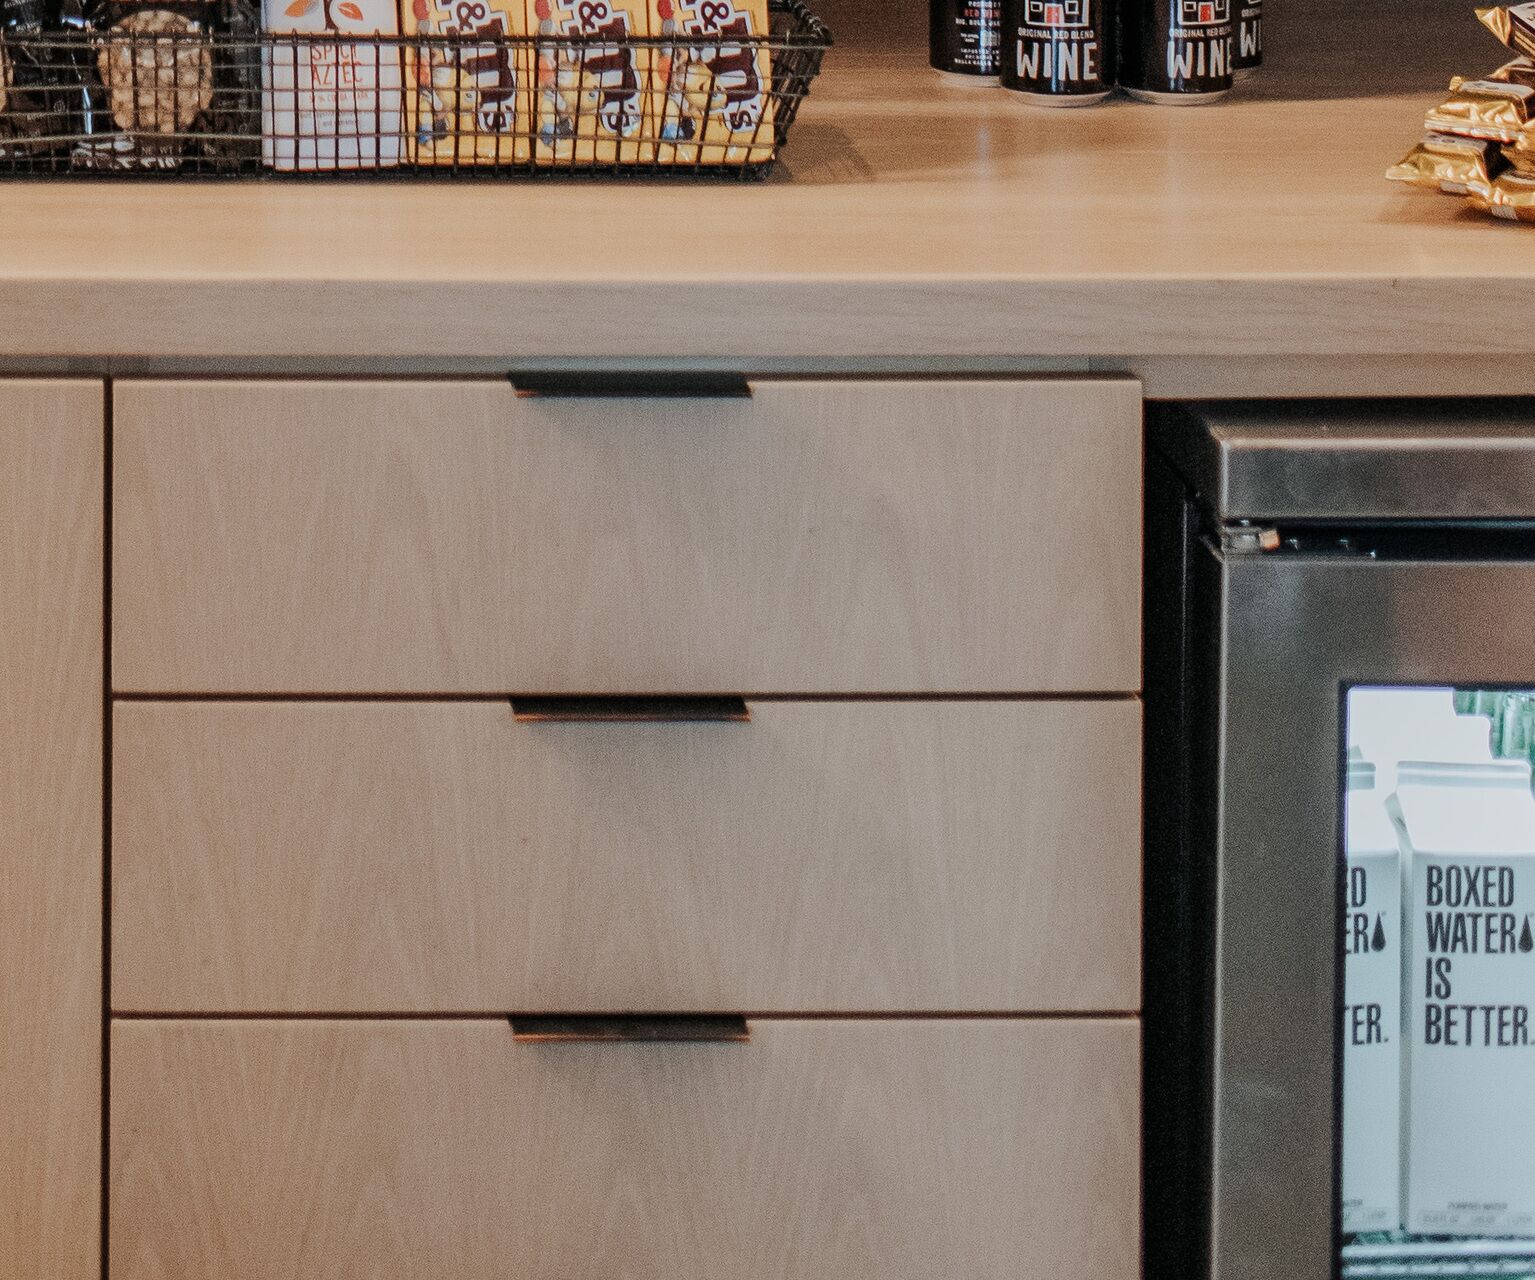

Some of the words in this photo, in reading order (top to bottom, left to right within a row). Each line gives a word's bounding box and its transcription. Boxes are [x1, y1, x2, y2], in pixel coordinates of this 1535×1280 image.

[1017, 27, 1052, 40] ORIGINAL
[1053, 28, 1069, 40] RED
[1070, 28, 1095, 40] BLEND
[1169, 27, 1205, 39] ORIGINAL
[1016, 40, 1100, 81] WINE
[1167, 39, 1233, 81] WINE
[1425, 864, 1515, 908] BOXED
[1425, 911, 1517, 955] WATER
[1425, 957, 1452, 1000] IS
[1424, 1004, 1535, 1047] BETTER.
